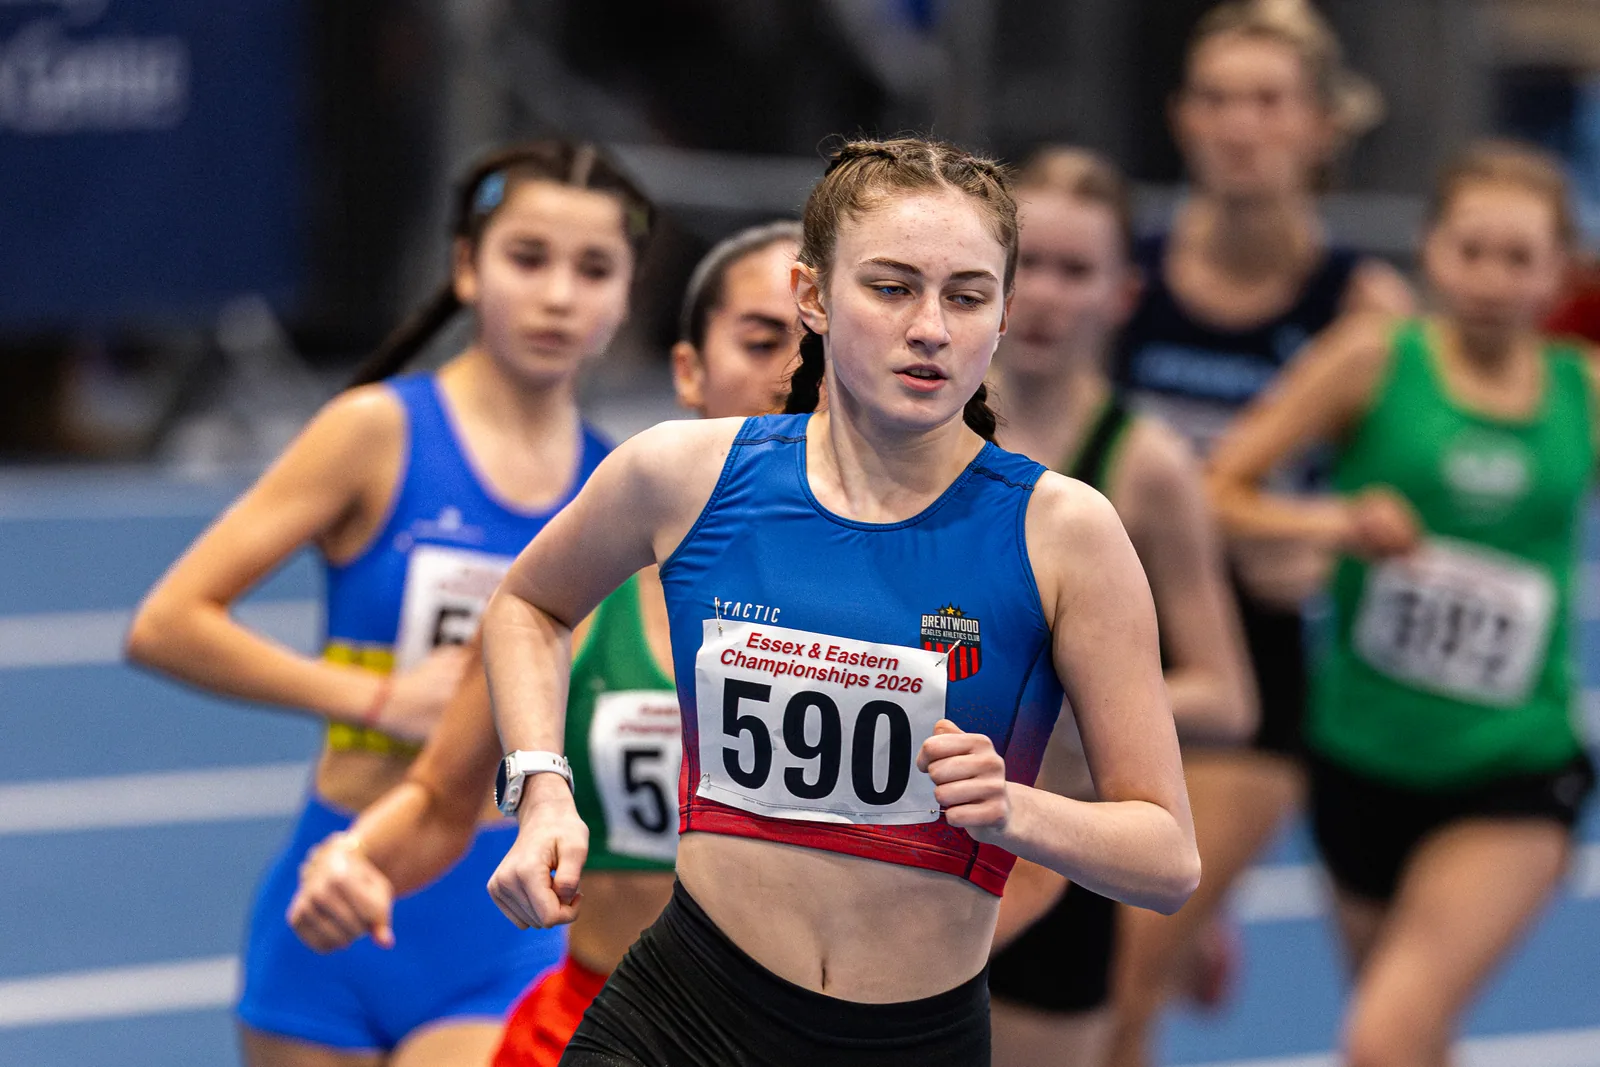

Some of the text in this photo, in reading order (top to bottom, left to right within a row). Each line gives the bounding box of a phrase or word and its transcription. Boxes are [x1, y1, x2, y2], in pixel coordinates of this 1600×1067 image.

[723, 601, 781, 623] TACTIC
[921, 614, 979, 634] BRENTWOOD
[921, 628, 980, 642] BEAGLES ATHLETICS CLUB
[746, 632, 899, 671] Essex & Eastern
[720, 648, 924, 694] Championships 2026
[722, 677, 912, 806] 590
